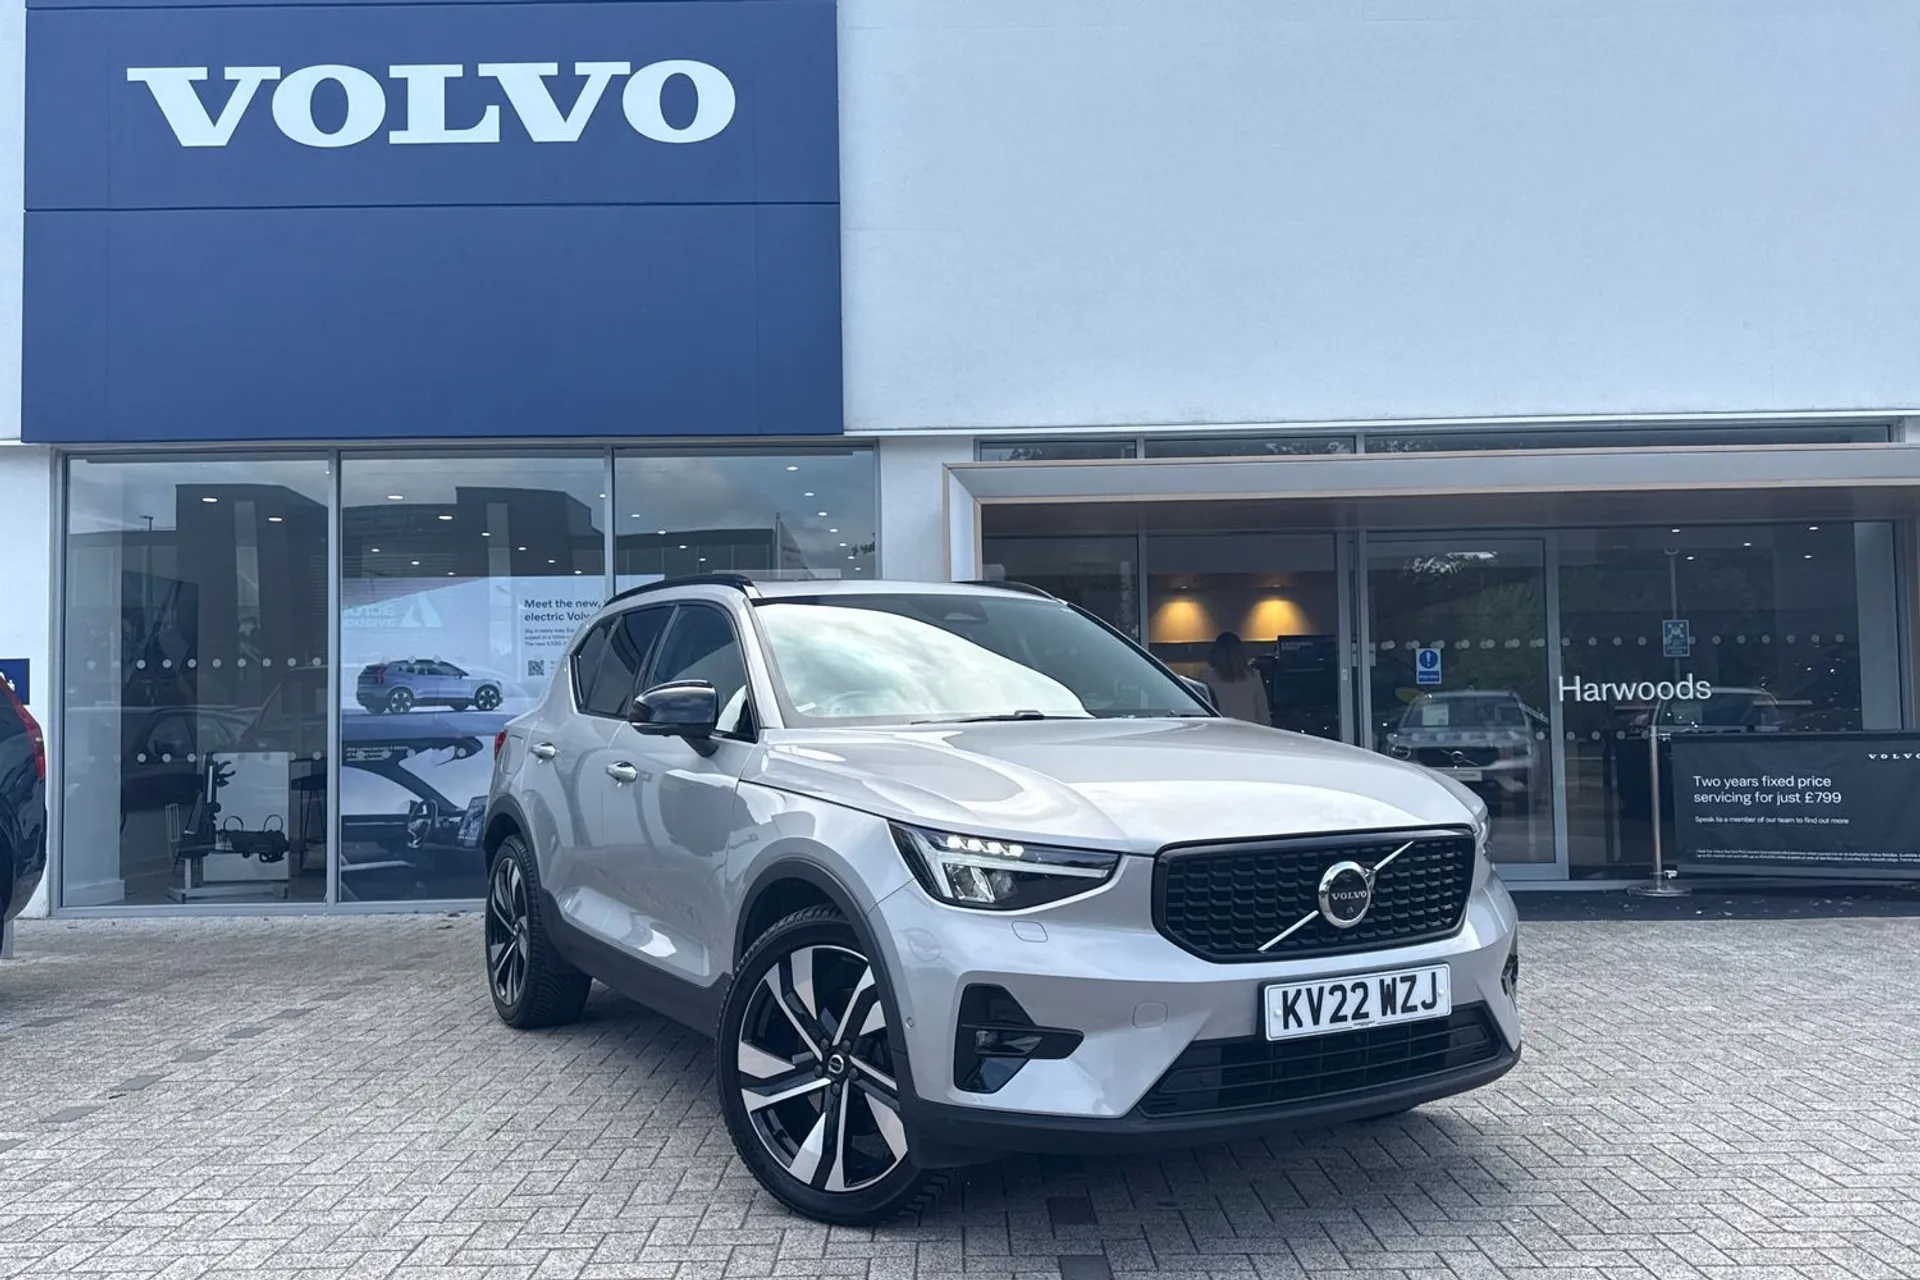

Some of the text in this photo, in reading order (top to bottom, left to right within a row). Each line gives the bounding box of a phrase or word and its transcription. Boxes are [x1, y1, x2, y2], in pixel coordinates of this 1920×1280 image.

[127, 59, 736, 148] VOLVO
[524, 599, 601, 609] Meet the new,
[524, 612, 591, 621] electric Volv
[1558, 673, 1712, 702] Harwoods
[1693, 775, 1832, 790] Two years fixed price
[1693, 791, 1842, 806] servicing for just £799
[1804, 816, 1817, 824] find
[1331, 890, 1367, 900] VOLVO
[1282, 971, 1438, 1030] KV22 WZJ
